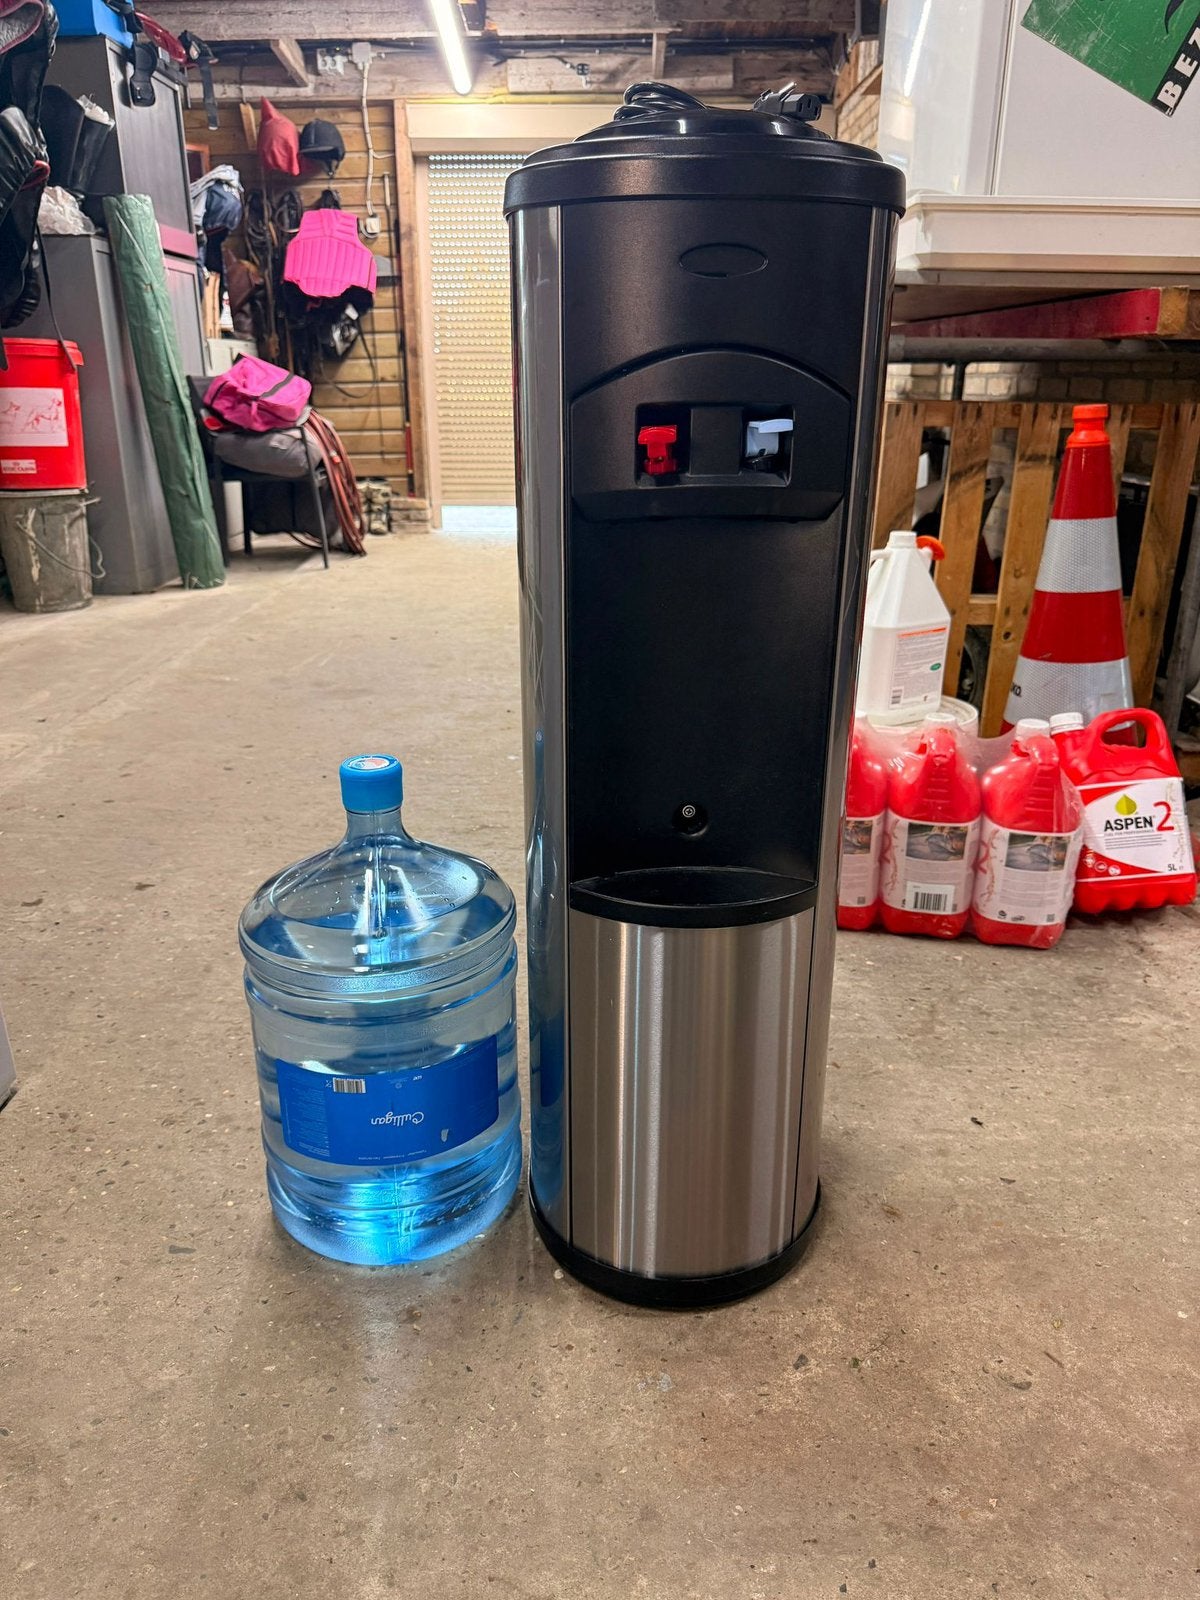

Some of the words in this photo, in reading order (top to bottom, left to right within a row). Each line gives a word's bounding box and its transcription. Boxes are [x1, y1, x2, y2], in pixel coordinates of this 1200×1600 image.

[1104, 815, 1154, 832] ASPEN
[1153, 801, 1174, 831] 2
[371, 1111, 424, 1127] Culligan
